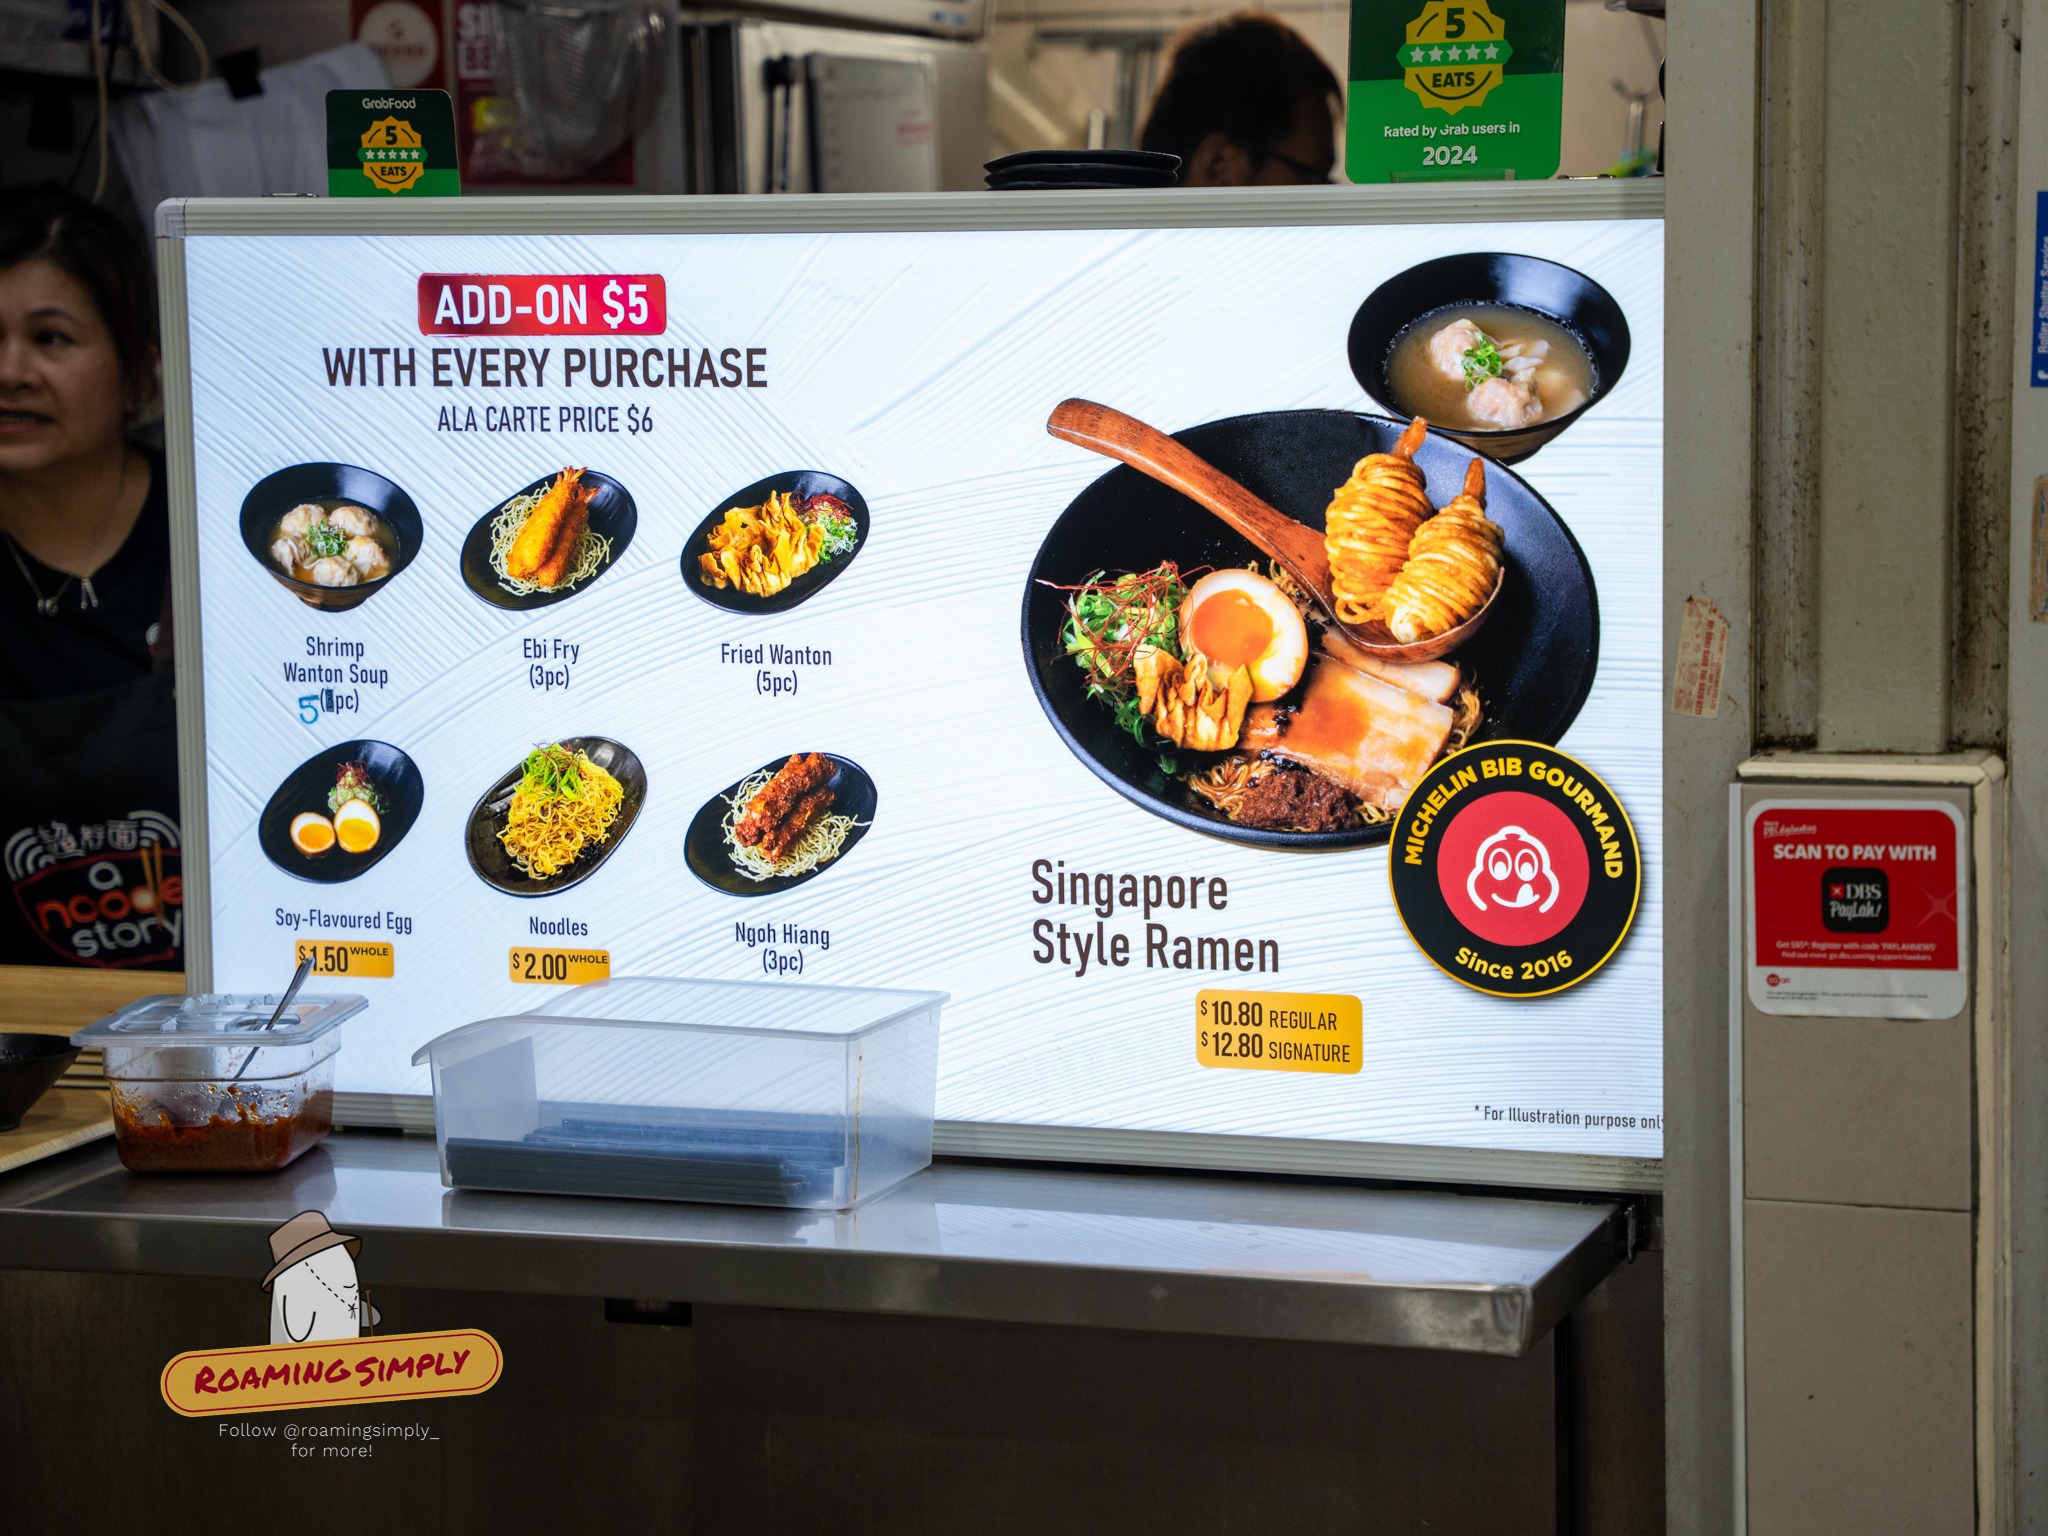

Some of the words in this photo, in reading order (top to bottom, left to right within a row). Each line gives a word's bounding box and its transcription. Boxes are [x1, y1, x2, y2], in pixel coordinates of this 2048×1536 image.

[1445, 7, 1466, 39] 5
[1432, 72, 1475, 88] EATS
[362, 97, 416, 110] GrabFood
[384, 126, 398, 145] 5
[1422, 124, 1437, 139] by
[1472, 123, 1506, 135] users
[1509, 121, 1520, 134] in
[1422, 145, 1478, 166] 2024
[380, 166, 408, 177] EATS
[434, 284, 587, 325] ADD-ON
[601, 280, 648, 329] $5
[322, 348, 417, 387] WITH
[432, 348, 550, 388] EVERY
[565, 348, 768, 389] PURCHASE
[437, 406, 478, 432] ALA
[486, 406, 550, 433] CARTE
[560, 406, 619, 434] PRICE
[627, 403, 653, 436] $6
[306, 636, 365, 662] Shrimp
[523, 638, 548, 659] Ebi
[554, 639, 580, 664] Fry
[721, 643, 764, 664] Fried
[770, 644, 832, 666] Wanton
[284, 662, 343, 684] Wanton
[349, 664, 388, 688] Soup
[530, 664, 570, 691] (3pc)
[756, 669, 798, 697] (5pc)
[298, 694, 320, 724] 5
[320, 688, 359, 714] (pc)
[1404, 765, 1478, 866] MICHELIN
[1481, 757, 1522, 779] BIB
[1528, 760, 1624, 879] GOURMAND
[1773, 844, 1822, 860] SCAN
[1826, 844, 1848, 860] TO
[1852, 845, 1886, 860] PAY
[1888, 845, 1936, 861] WITH
[88, 861, 123, 891] a
[1032, 858, 1228, 920] Singapore
[1846, 884, 1882, 900] DBS
[275, 908, 381, 931] Soy-Flavoured
[386, 912, 412, 935] Egg
[1829, 900, 1882, 922] PayLah!
[72, 910, 182, 958] story
[530, 916, 588, 936] Noodles
[736, 922, 776, 948] Ngoh
[783, 924, 830, 950] Hiang
[350, 946, 389, 956] WHOLE
[568, 954, 608, 964] WHOLE
[1032, 918, 1130, 978] Style
[1146, 922, 1279, 973] Ramen
[1842, 942, 1860, 950] with
[1861, 942, 1880, 950] code
[763, 948, 804, 976] (3pc)
[1455, 947, 1514, 980] Since
[1521, 950, 1573, 980] 2016
[1269, 1010, 1338, 1031] REGULAR
[1268, 1041, 1350, 1063] SIGNATURE
[1484, 1105, 1504, 1121] For
[1508, 1107, 1580, 1125] Illustration
[1584, 1114, 1636, 1130] purpose
[1640, 1115, 1664, 1134] onl
